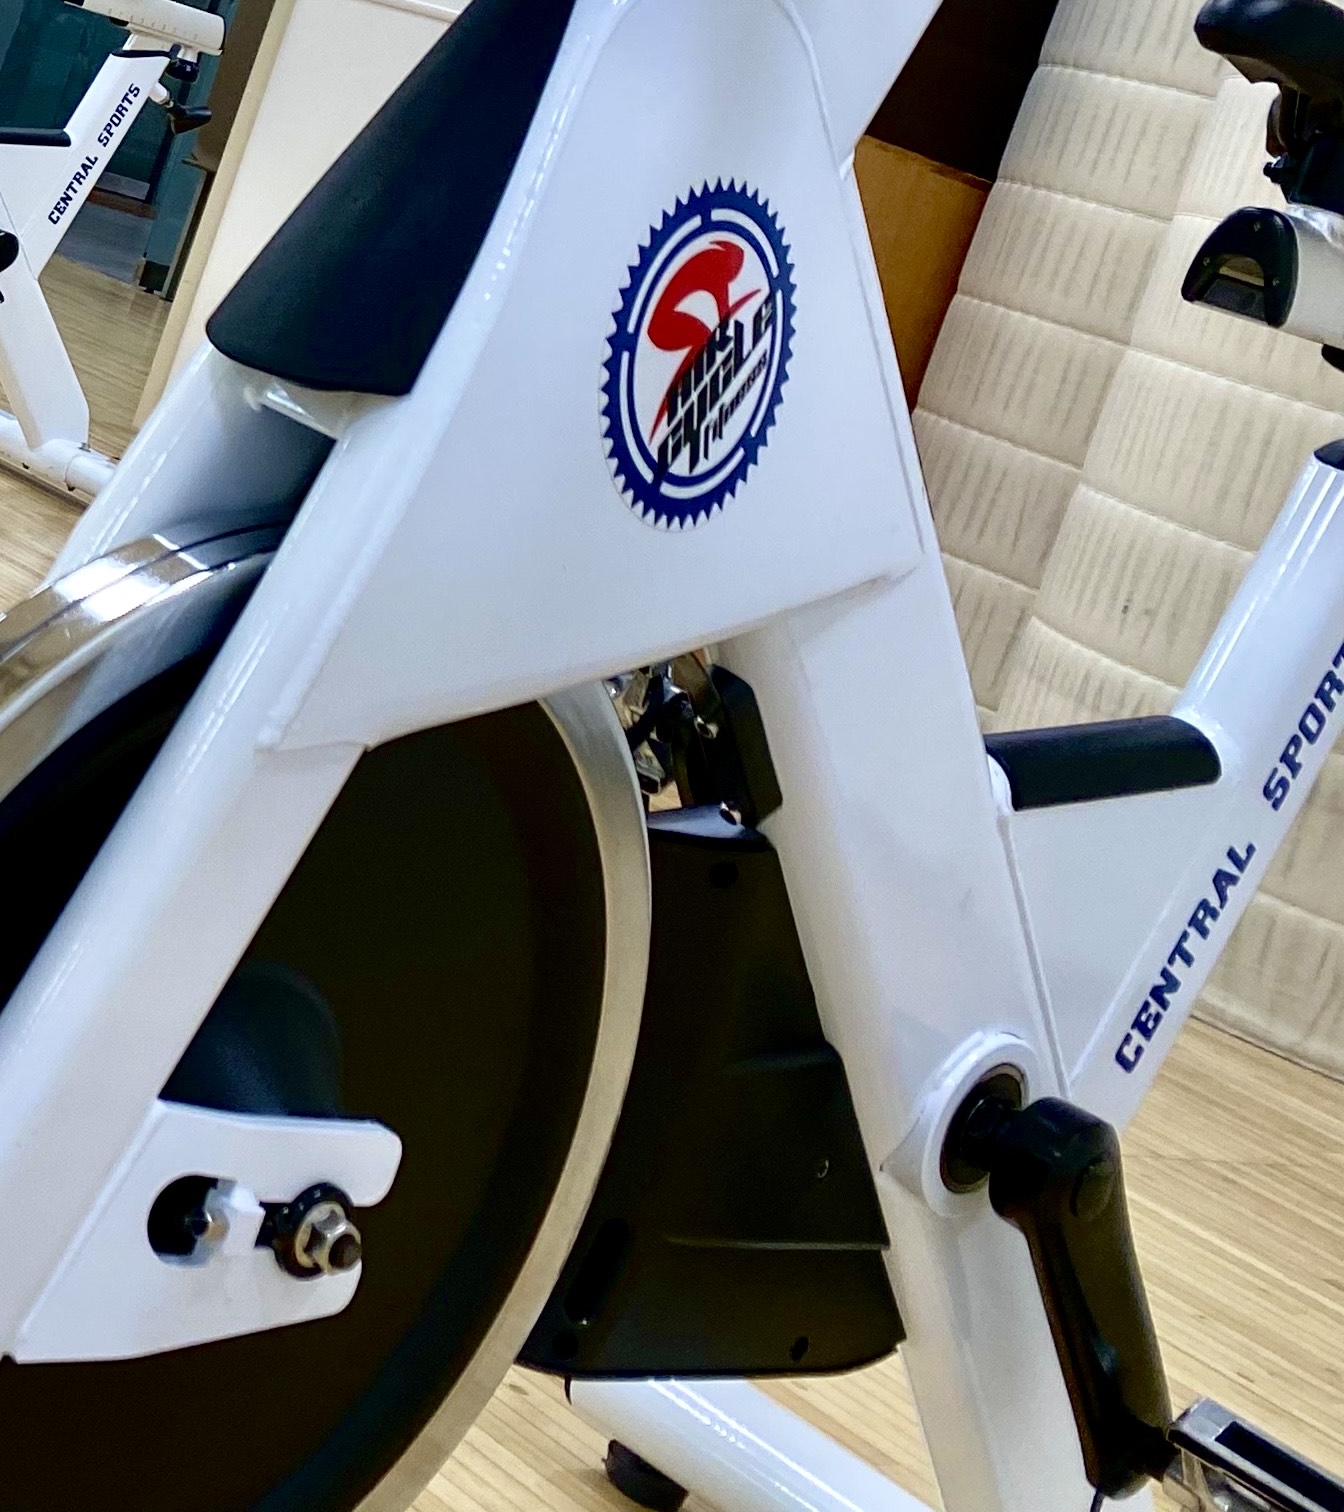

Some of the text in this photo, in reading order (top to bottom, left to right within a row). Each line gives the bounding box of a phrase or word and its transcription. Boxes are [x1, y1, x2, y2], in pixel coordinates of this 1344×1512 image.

[47, 82, 141, 225] CENTRAL SPORTS
[1115, 842, 1256, 1074] CENTRAL
